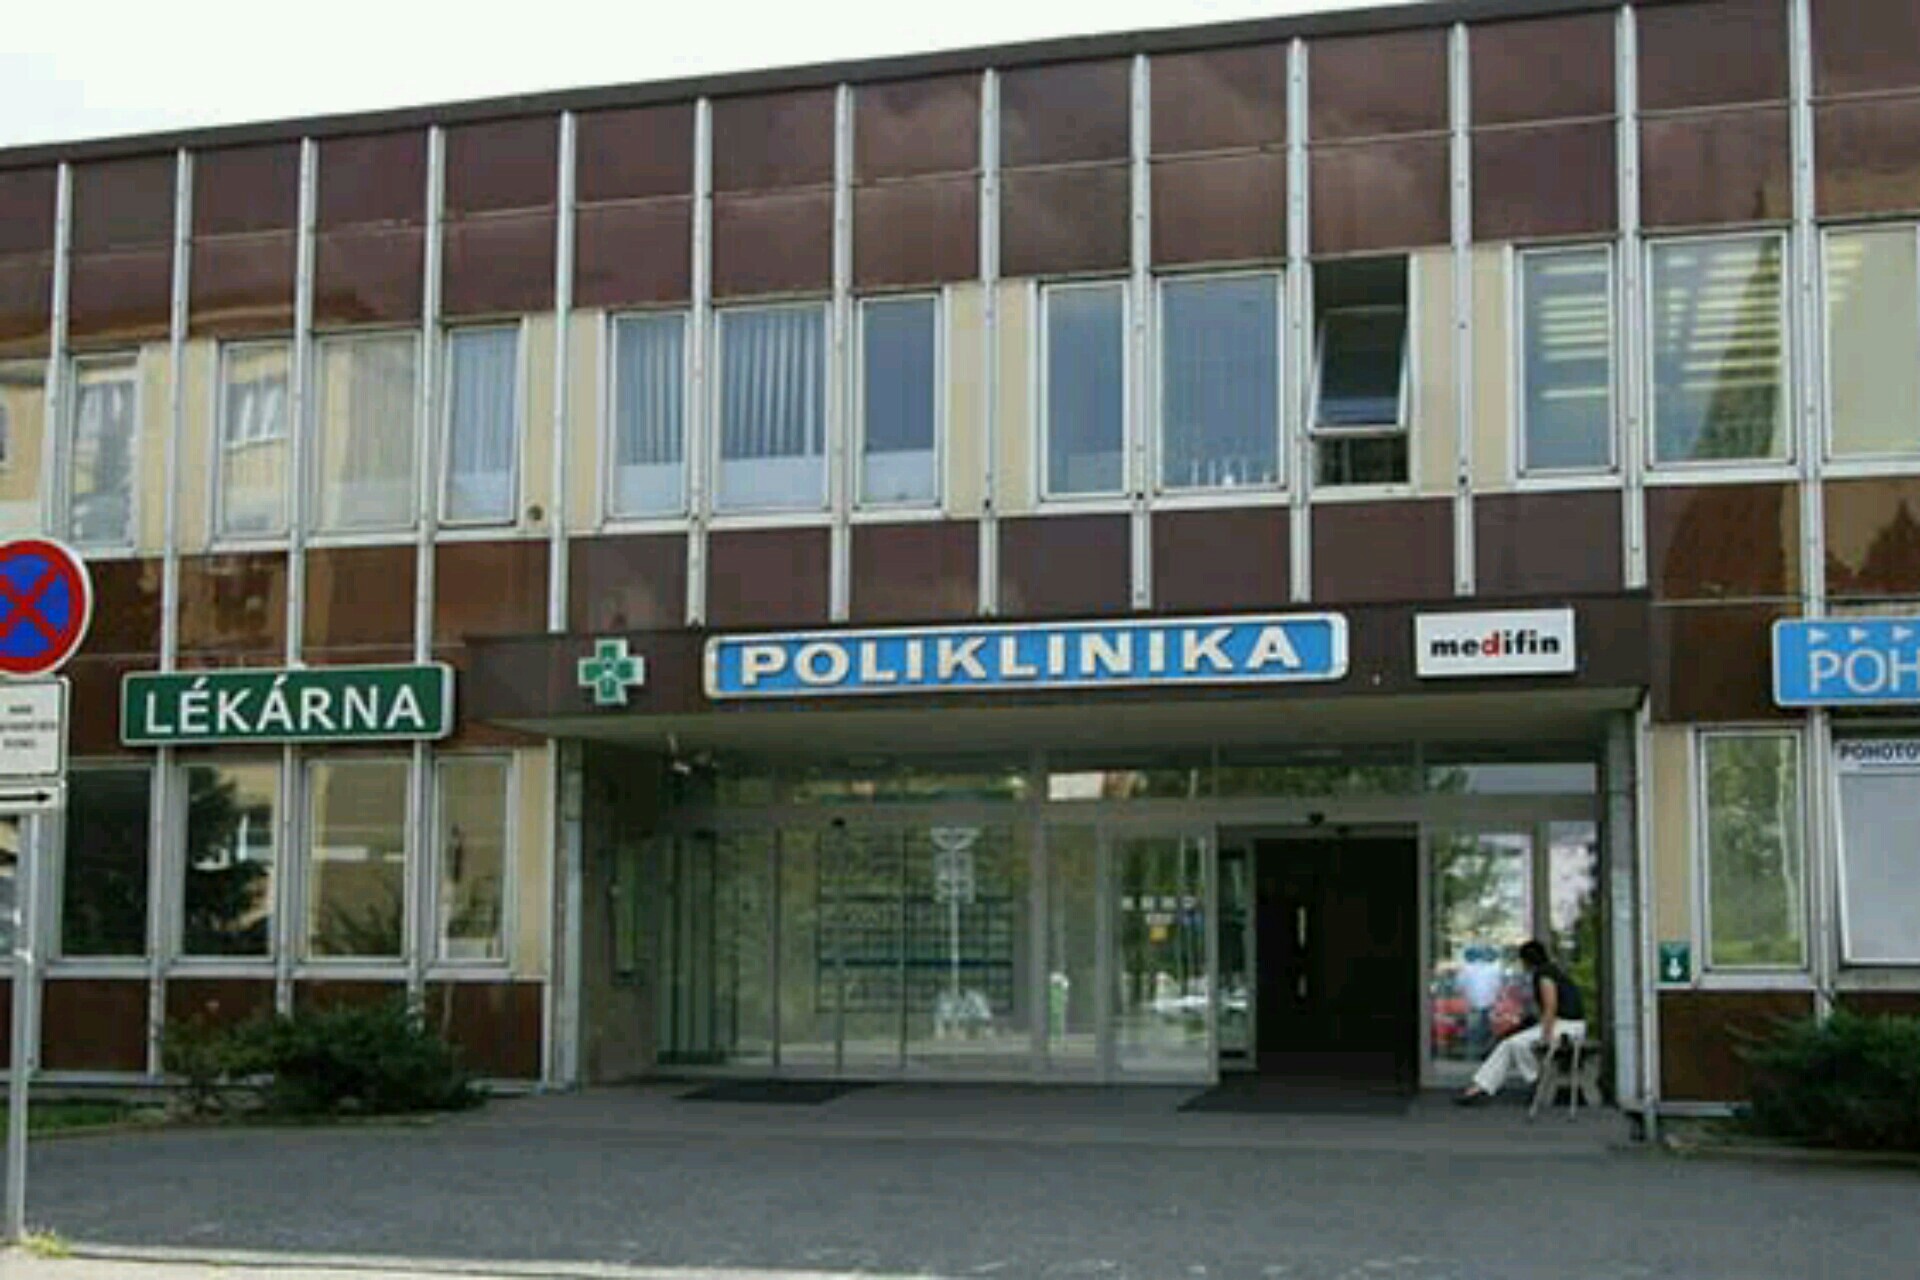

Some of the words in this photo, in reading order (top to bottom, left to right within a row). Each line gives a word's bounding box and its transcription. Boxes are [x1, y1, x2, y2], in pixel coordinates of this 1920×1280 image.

[740, 627, 1302, 685] POLIKLINIKA
[1430, 629, 1560, 657] medifin
[146, 675, 425, 734] LÉKÁRNA
[1840, 741, 1920, 760] POHOTO
